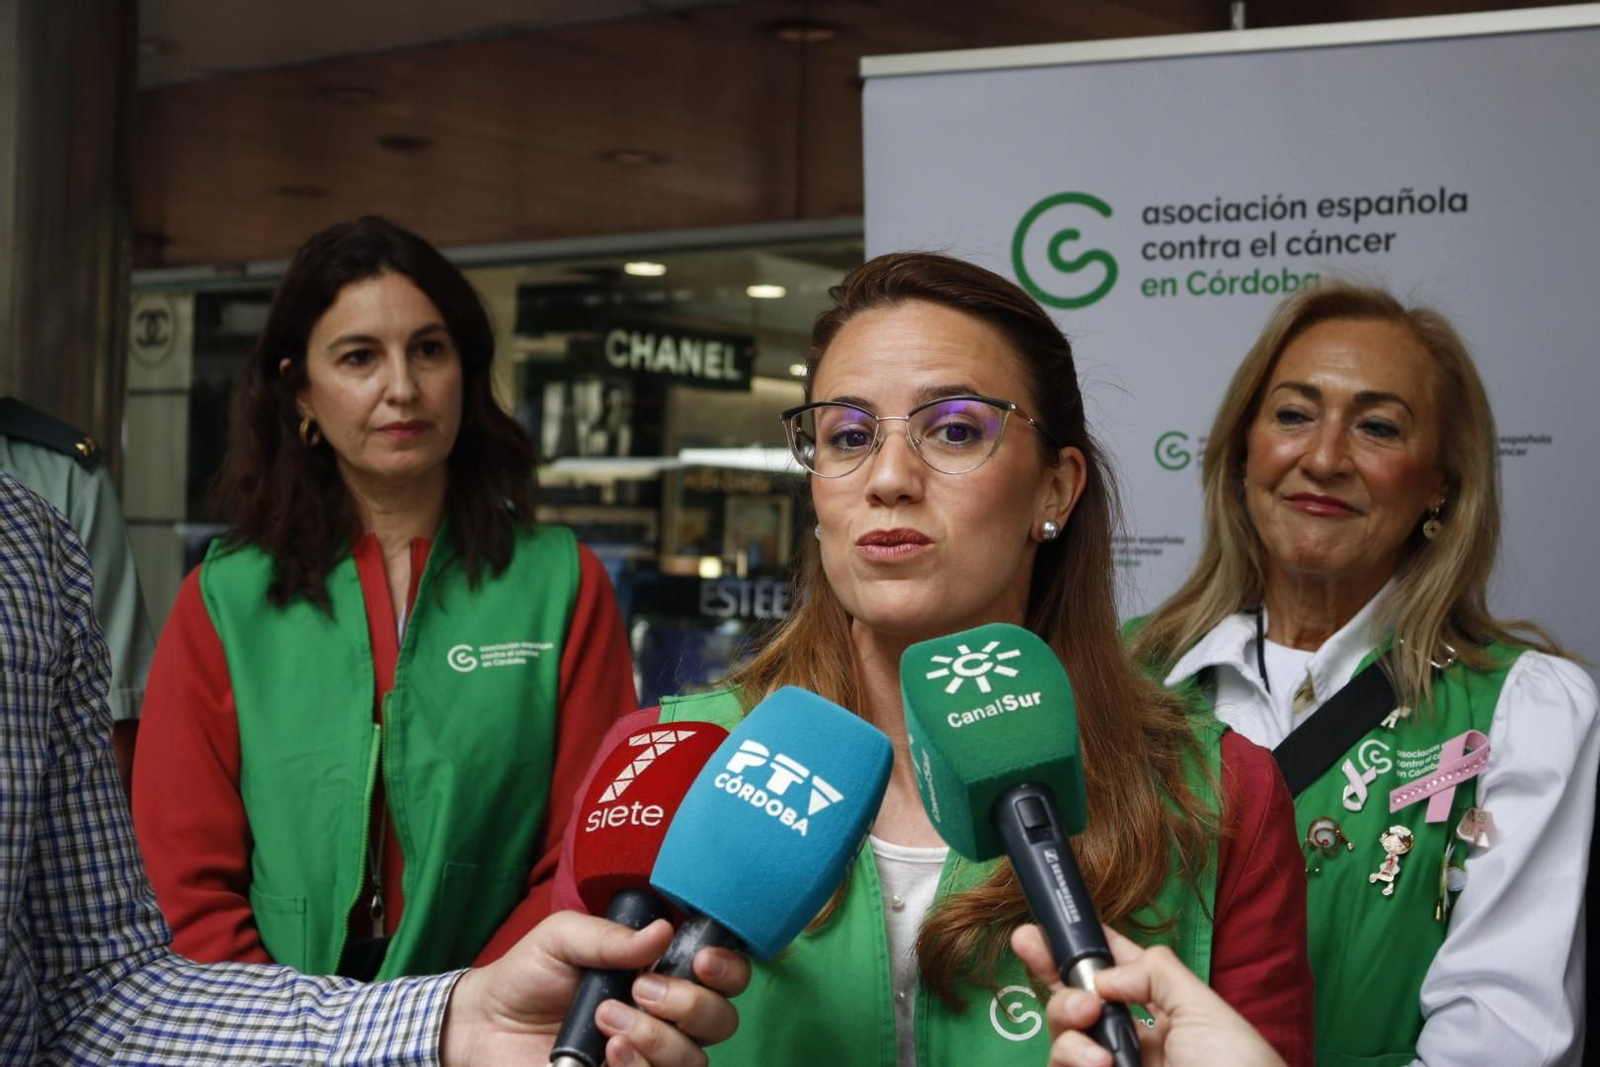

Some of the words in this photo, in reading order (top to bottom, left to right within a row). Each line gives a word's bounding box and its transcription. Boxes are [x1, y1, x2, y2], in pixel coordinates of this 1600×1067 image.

[1142, 194, 1307, 225] asociación
[1317, 187, 1469, 224] española
[1141, 235, 1241, 261] contra
[1250, 231, 1277, 257] el
[1285, 229, 1397, 256] cáncer
[1140, 276, 1178, 297] en
[605, 328, 743, 381] CHANEL
[713, 773, 810, 837] CÓRDOBA
